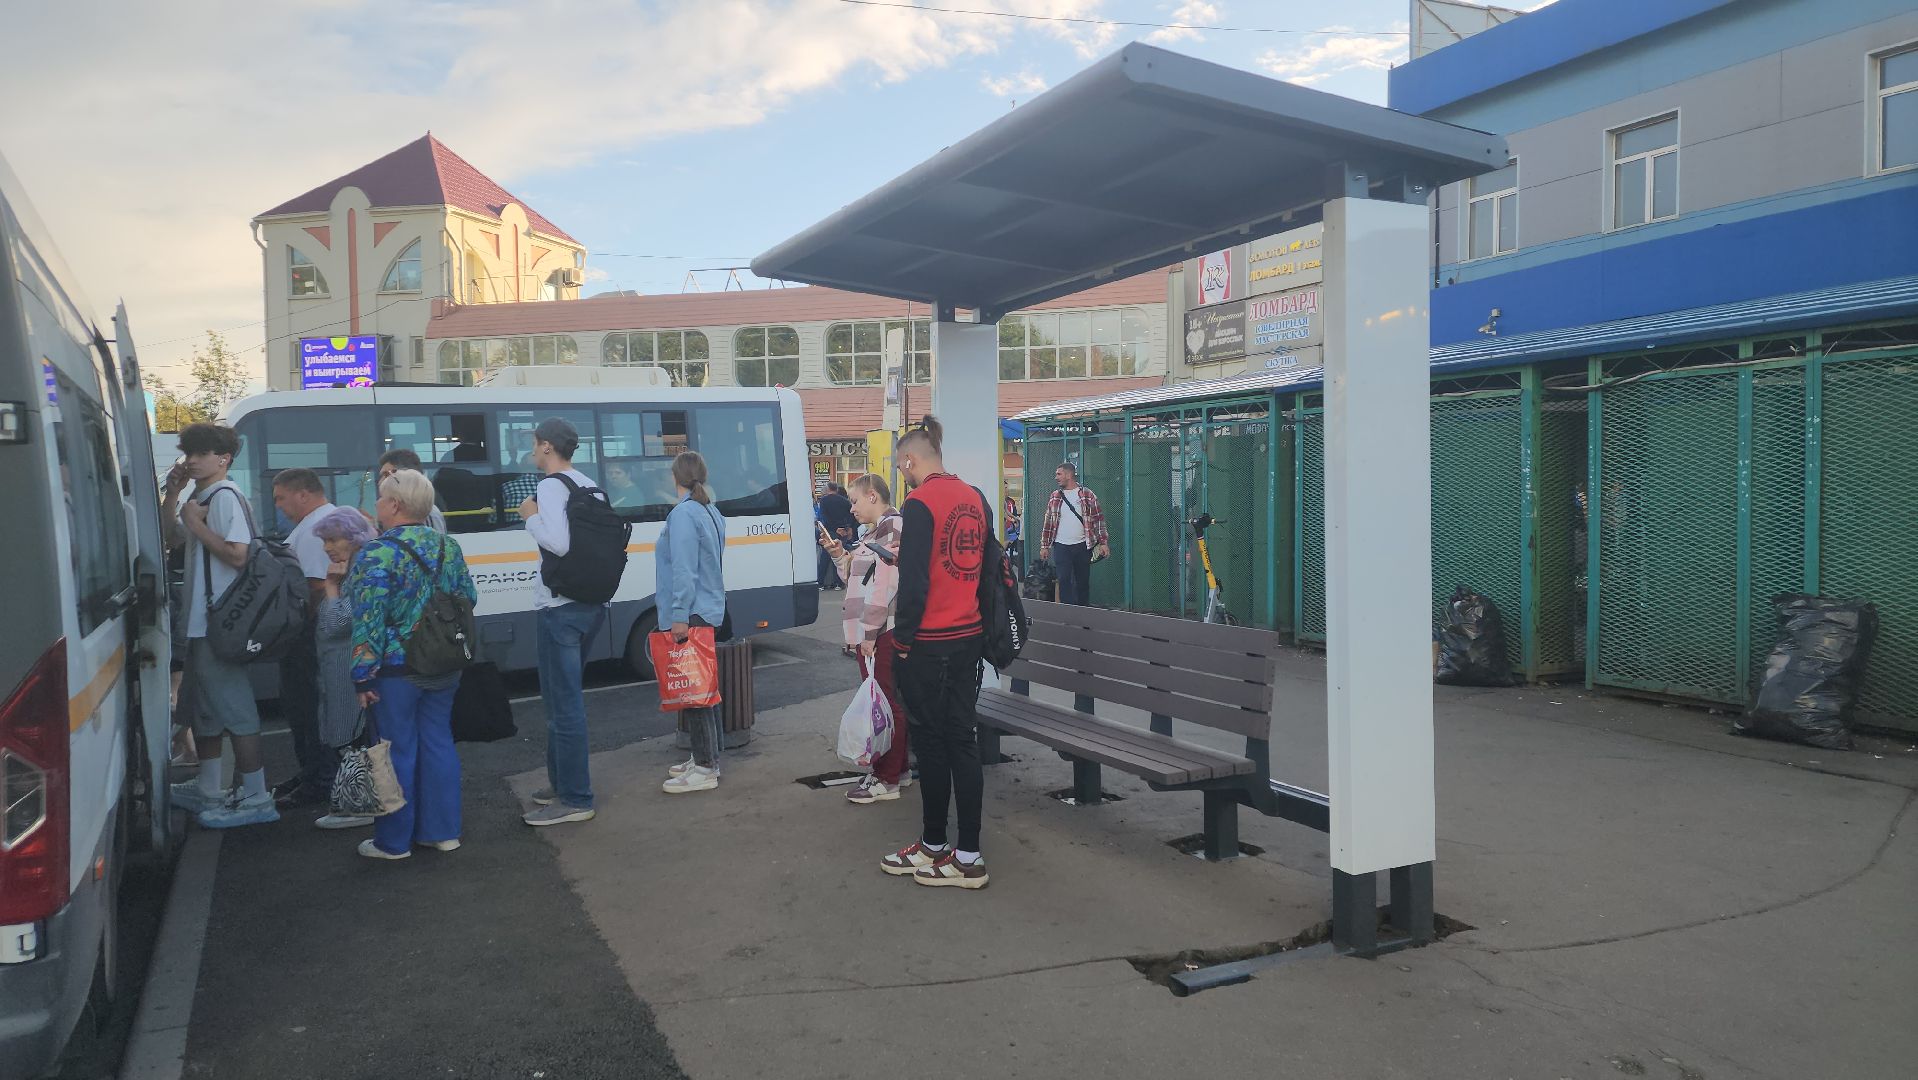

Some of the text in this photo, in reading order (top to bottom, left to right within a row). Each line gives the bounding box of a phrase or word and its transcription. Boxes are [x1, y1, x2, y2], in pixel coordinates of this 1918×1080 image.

[1249, 263, 1294, 281] ЛОМБАРД
[1249, 291, 1318, 321] ЛОМБАРД
[1255, 317, 1309, 334] ЮВЕЛИРНАЯ
[1255, 328, 1309, 346] МАСТЕРСКАЯ
[304, 352, 356, 367] улыбаемся
[1264, 355, 1298, 368] СКУПКА
[305, 366, 371, 379] и выигрываем
[809, 441, 868, 456] STIC'S
[746, 522, 786, 536] 101064
[470, 570, 538, 585] РАНСА
[222, 574, 267, 632] VAMOS
[667, 679, 701, 691] KRUPS
